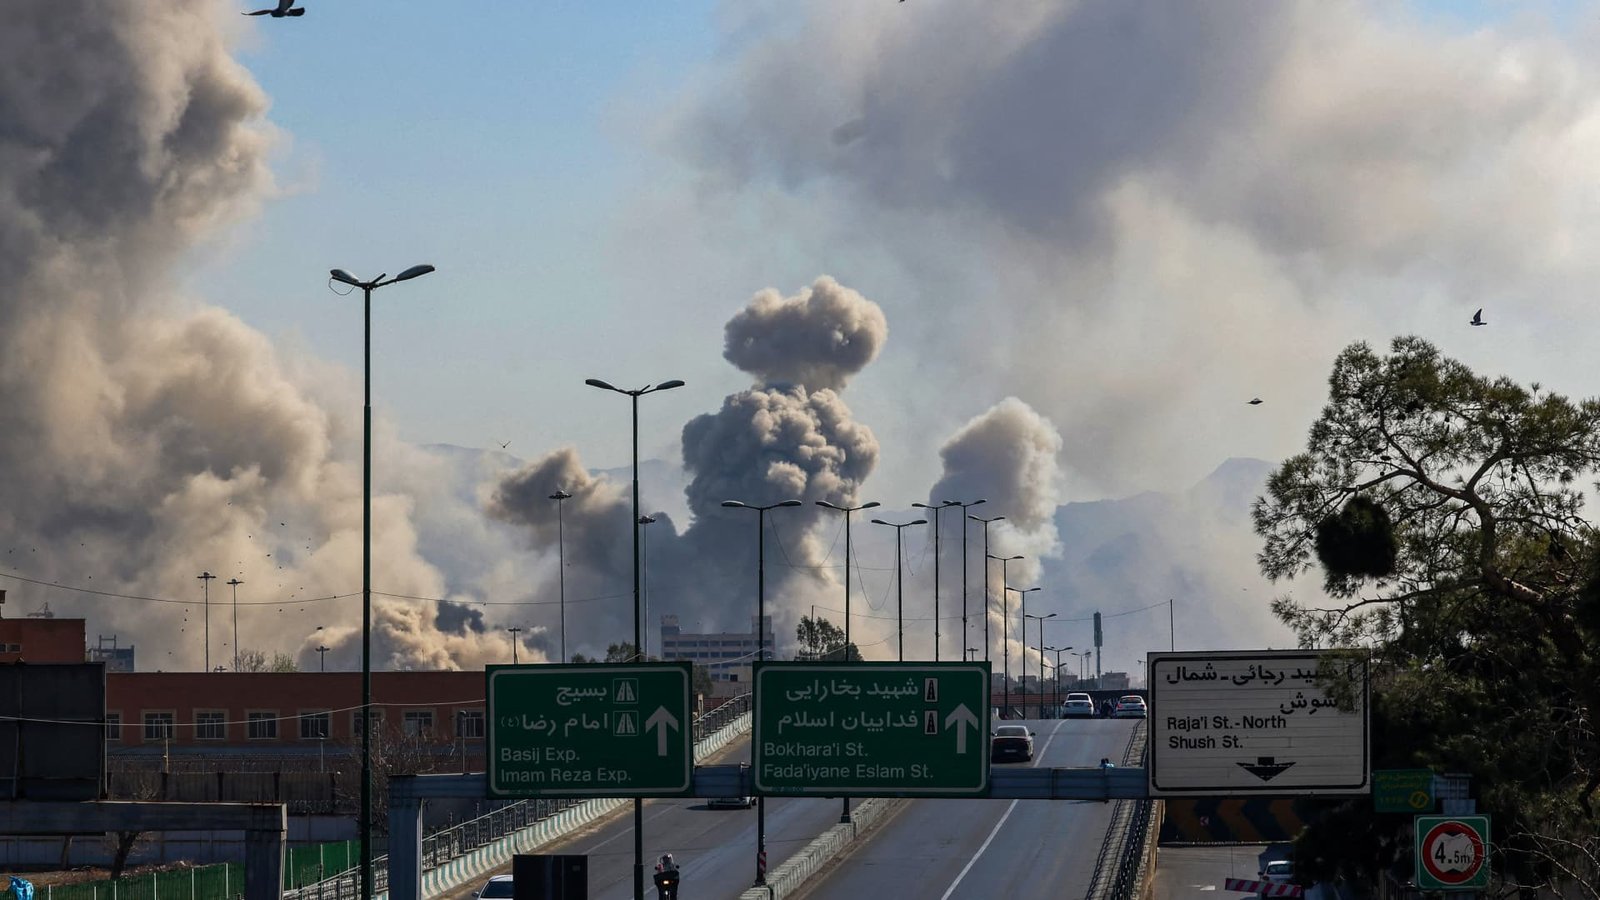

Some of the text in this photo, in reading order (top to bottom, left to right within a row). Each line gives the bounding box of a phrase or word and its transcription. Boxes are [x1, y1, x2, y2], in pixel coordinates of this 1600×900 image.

[555, 685, 608, 706] بسیج
[786, 678, 919, 703] شهید بخارایی
[564, 712, 609, 737] امام
[777, 709, 919, 735] فداییان اسلام
[1167, 716, 1208, 733] Raja'i
[764, 742, 869, 757] Bokhara'i St.
[1168, 735, 1244, 749] Shush St.
[500, 747, 580, 766] Basij Exp.
[501, 768, 632, 784] Imam Reza Exp.
[764, 763, 934, 781] Fada'iyane Eslam St.
